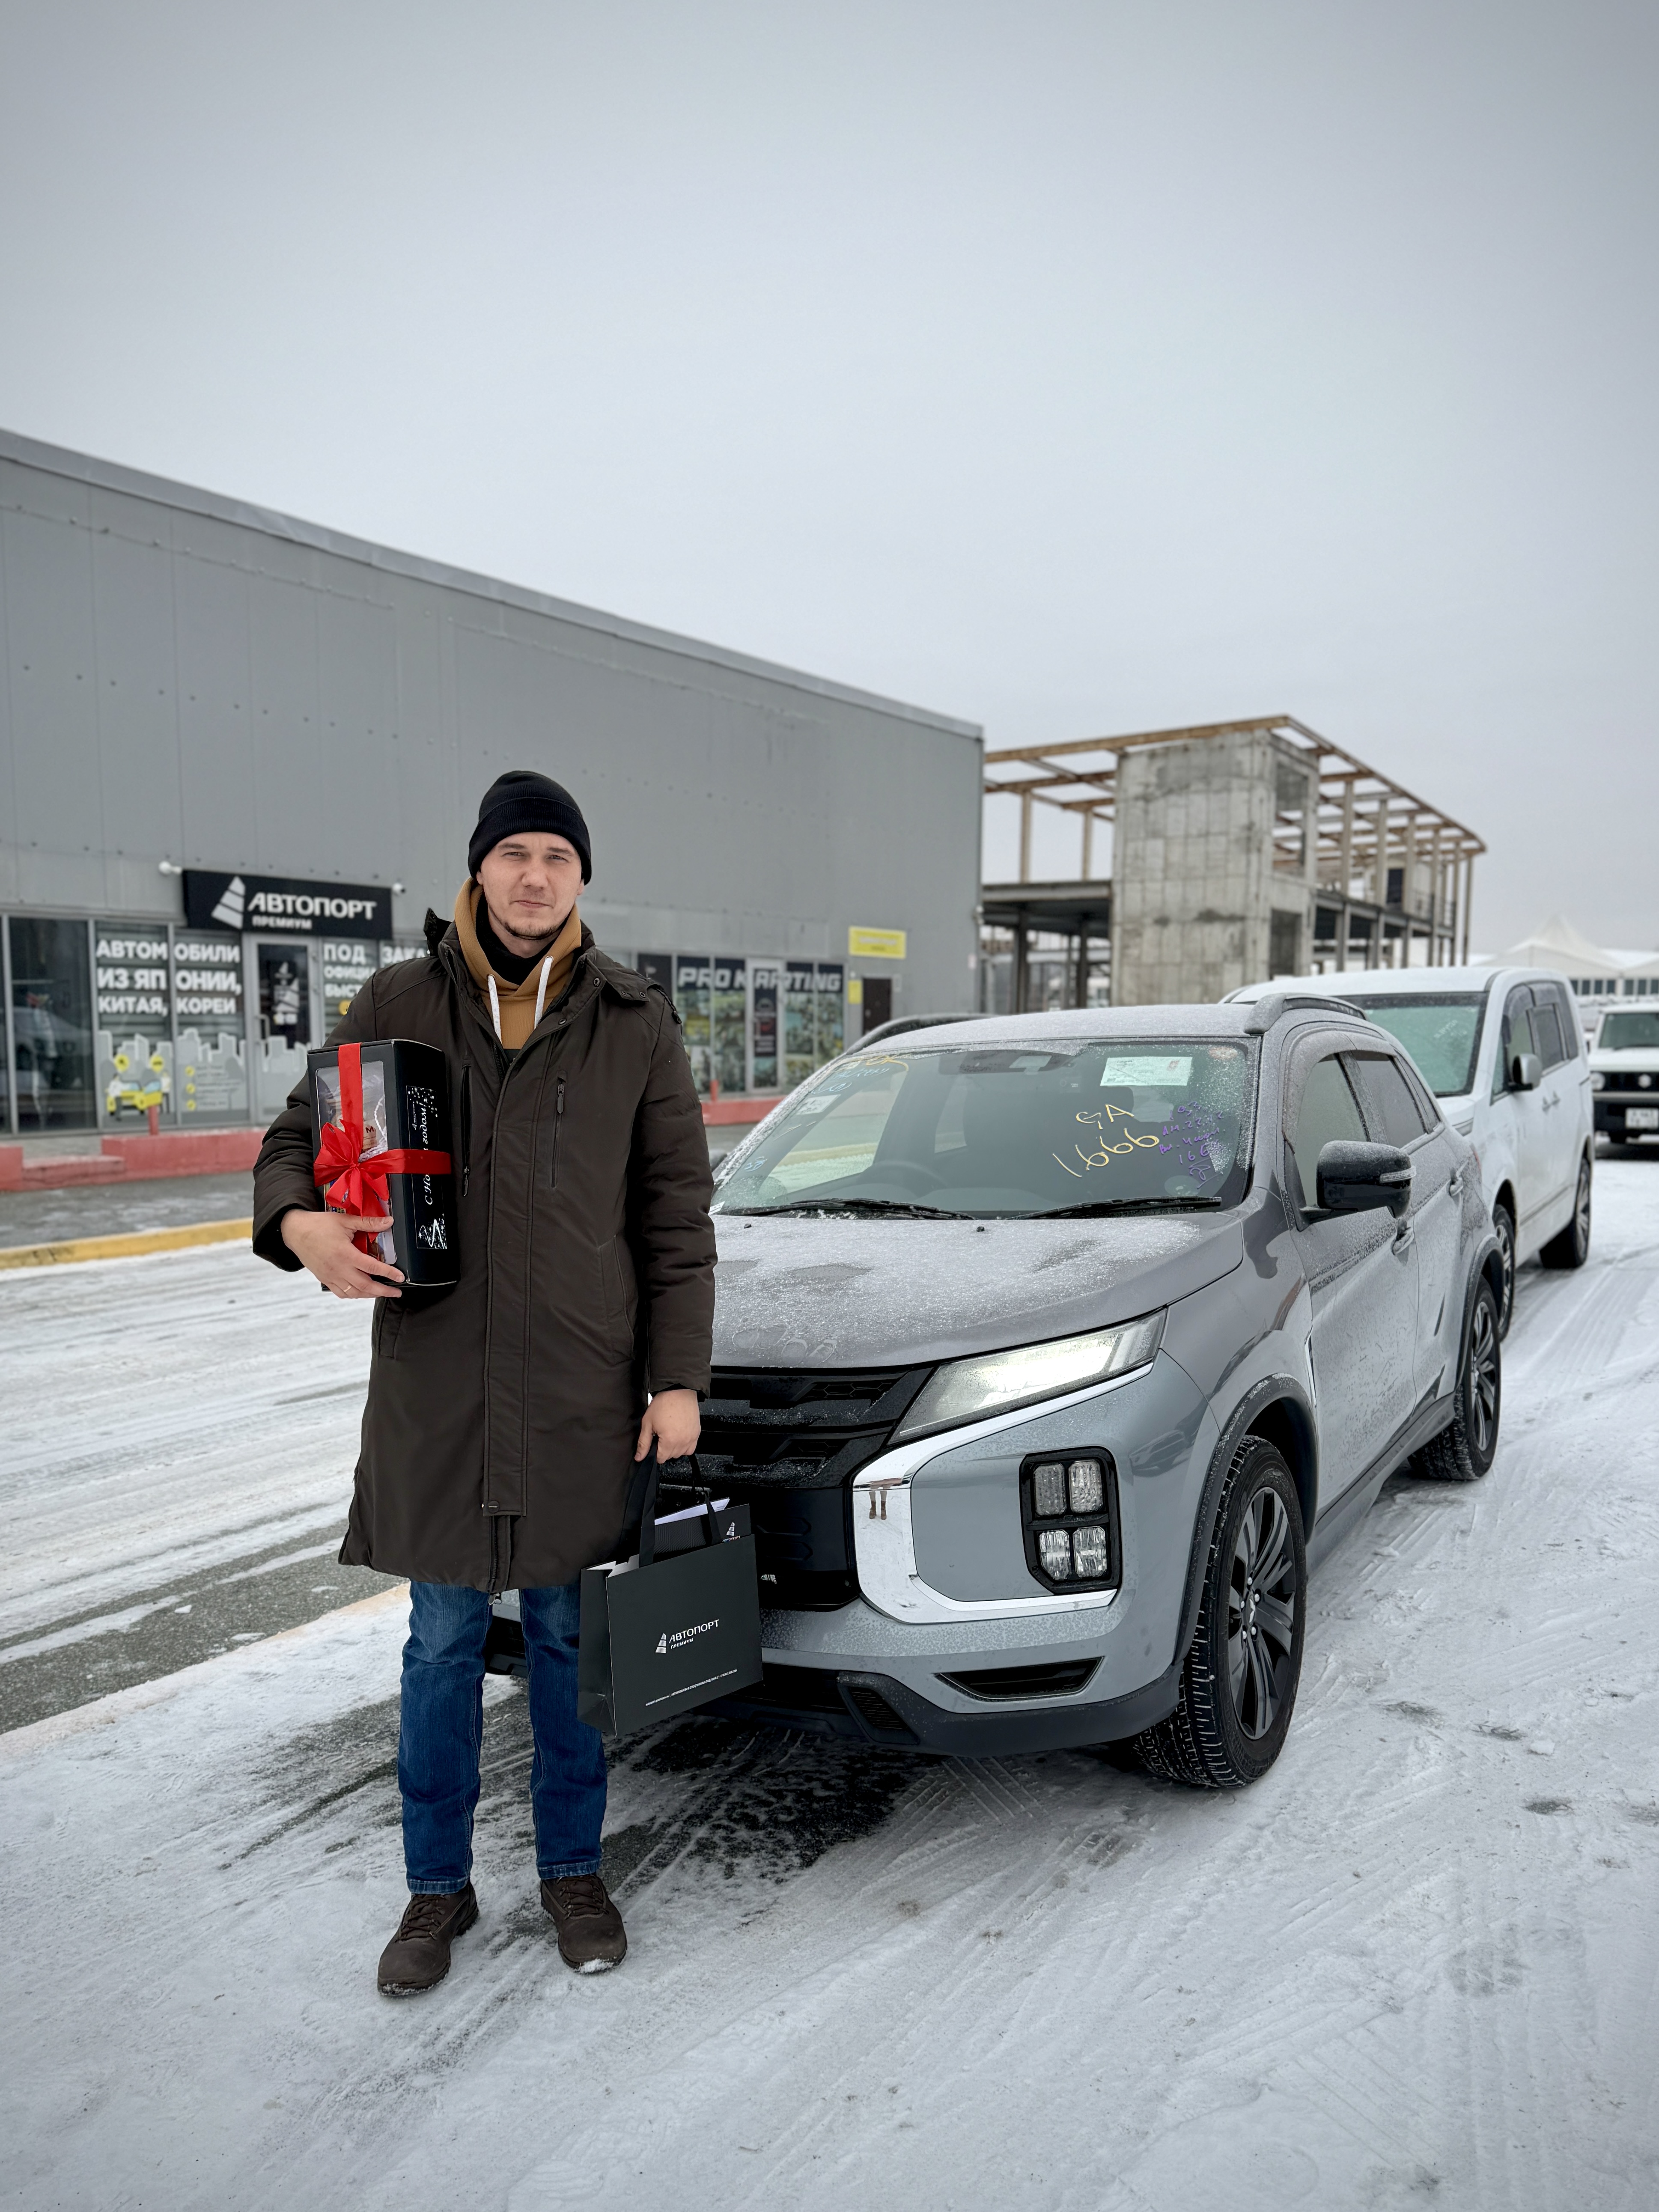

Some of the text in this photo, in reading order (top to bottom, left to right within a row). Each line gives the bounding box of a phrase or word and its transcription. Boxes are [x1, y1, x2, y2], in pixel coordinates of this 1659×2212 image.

[247, 892, 377, 920] АВТОПОРТ
[252, 915, 313, 930] ПРЕМИУМ
[323, 943, 430, 965] ПОД ЗАКА
[97, 968, 129, 989] ИЗ
[679, 967, 731, 988] PRO
[98, 996, 168, 1017] КИТАЯ,
[669, 1619, 720, 1643] АВТОПОРТ
[670, 1637, 694, 1649] ПРЕМИУМ
